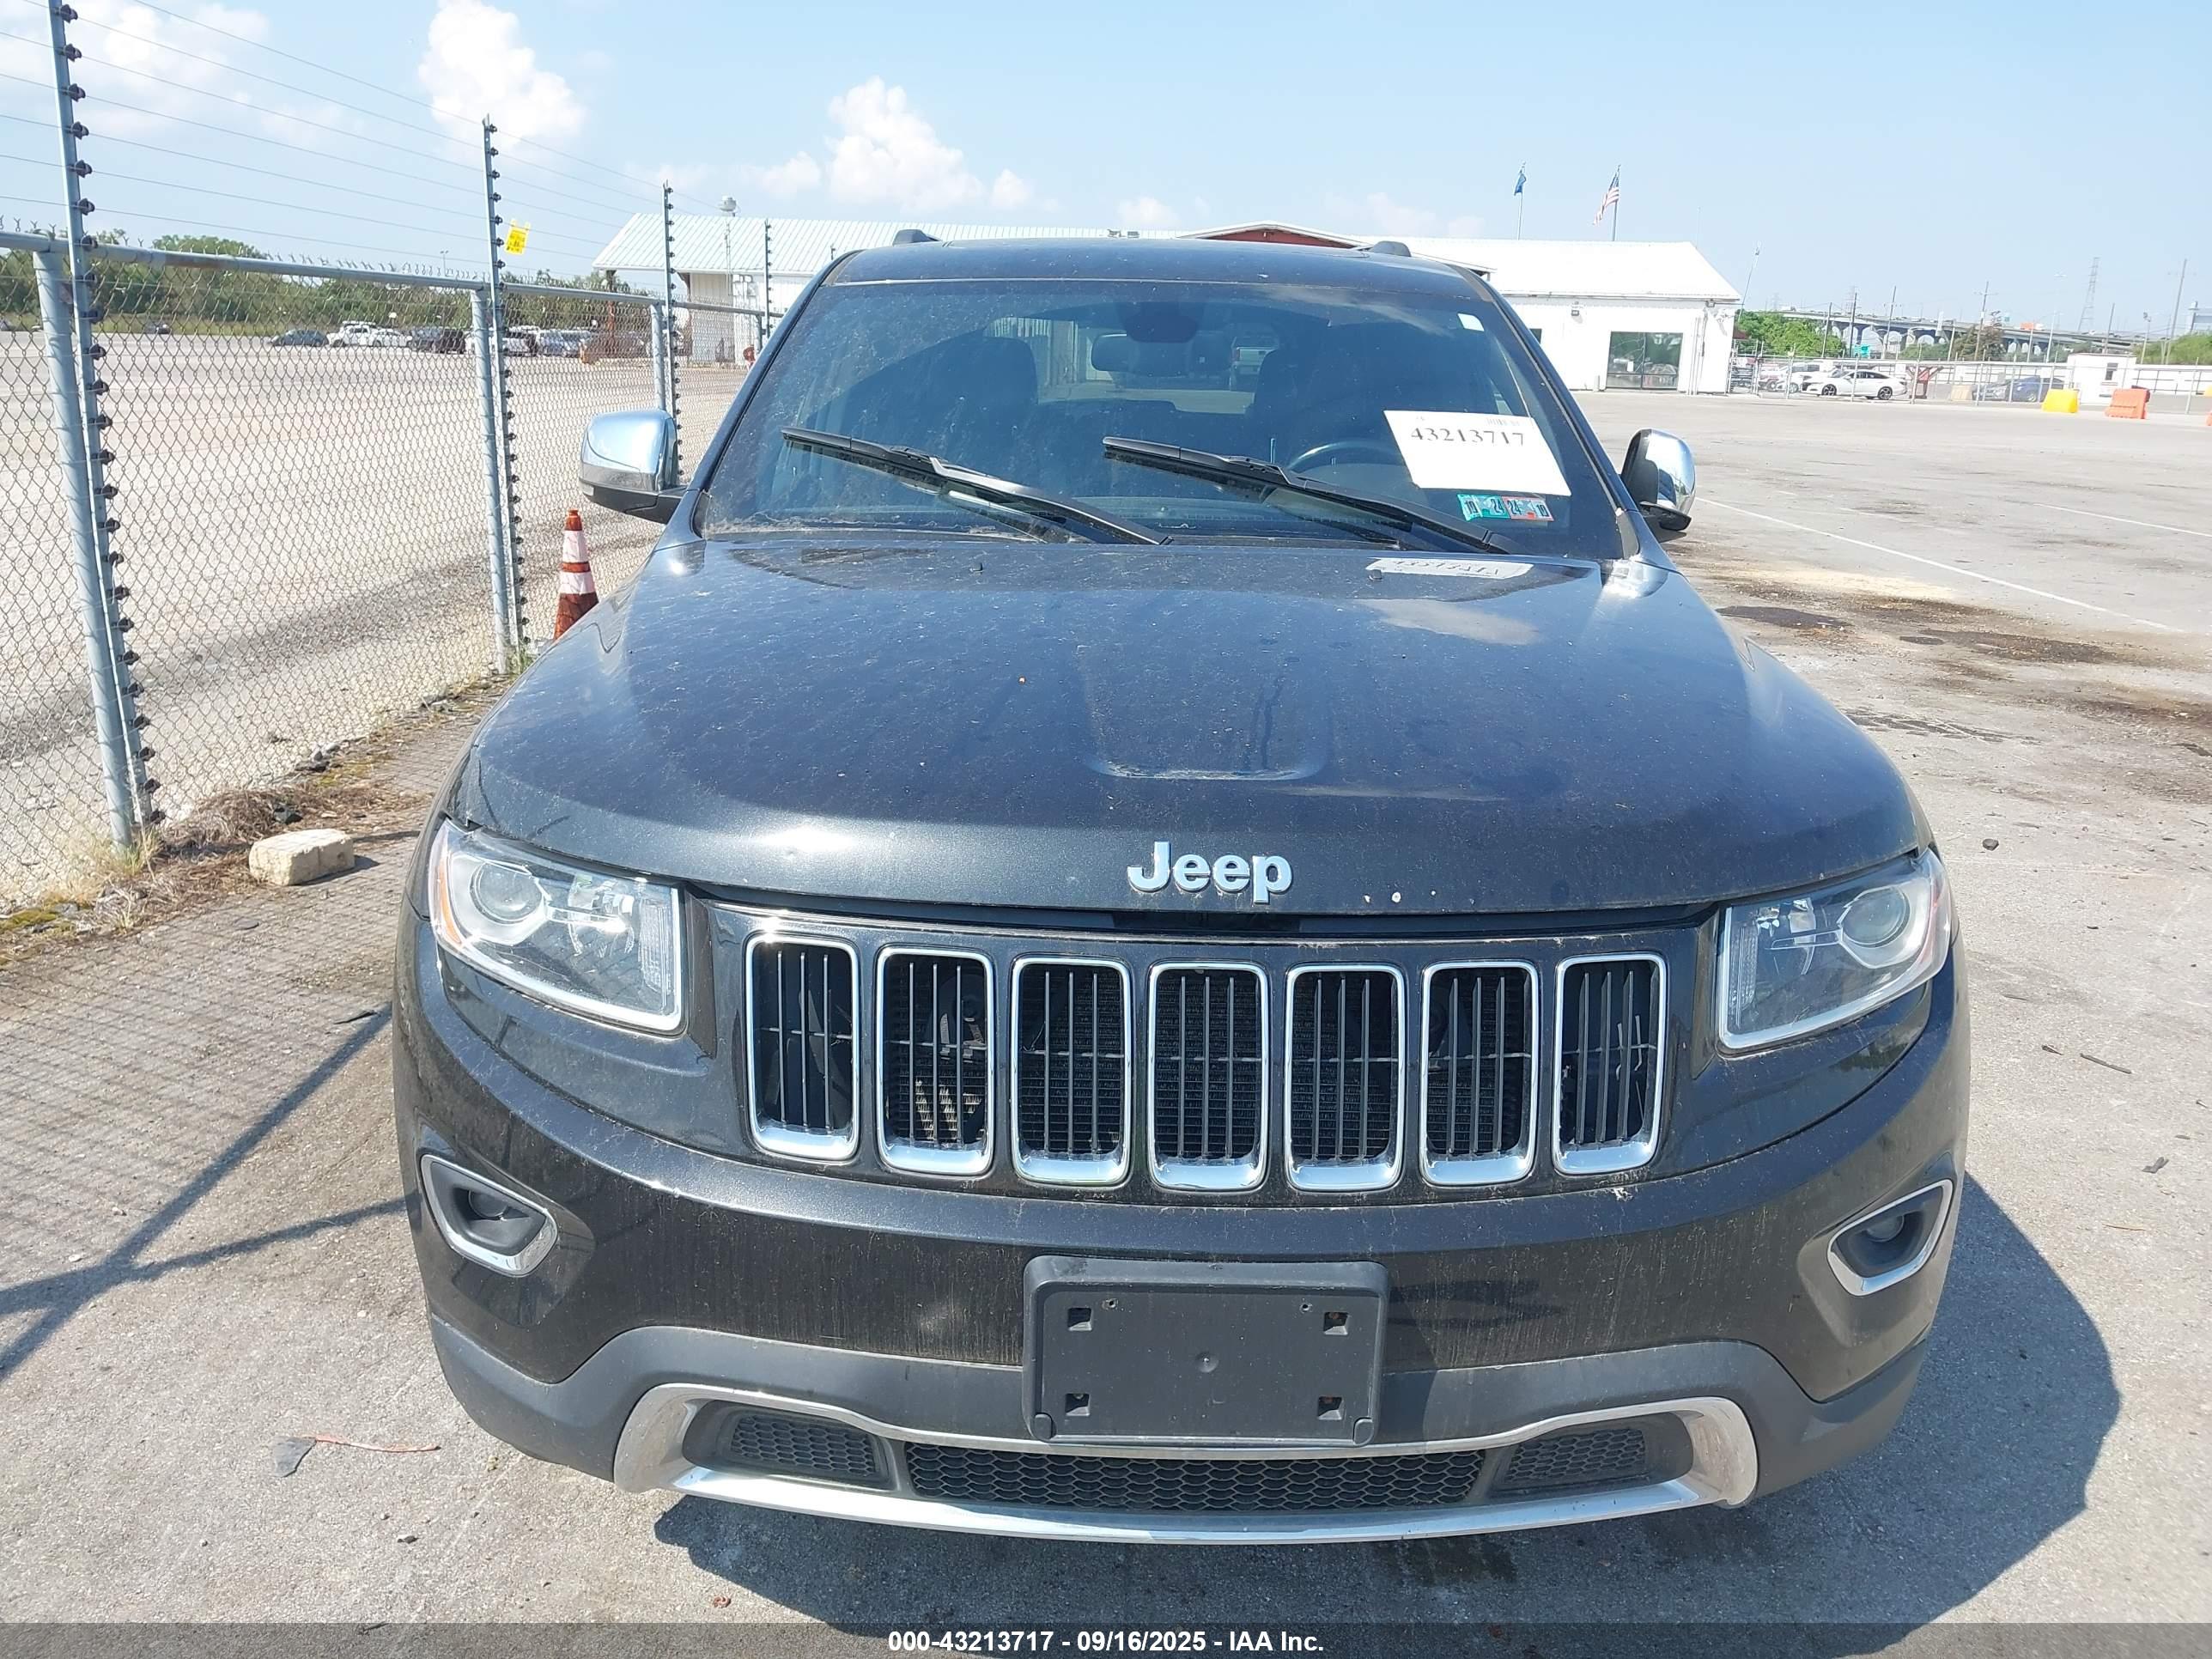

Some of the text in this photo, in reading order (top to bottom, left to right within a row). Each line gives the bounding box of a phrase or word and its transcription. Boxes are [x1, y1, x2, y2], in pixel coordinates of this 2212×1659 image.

[1411, 428, 1523, 447] 43213717
[1491, 499, 1505, 514] 24
[1507, 500, 1522, 515] 24
[1127, 842, 1293, 904] Jeep
